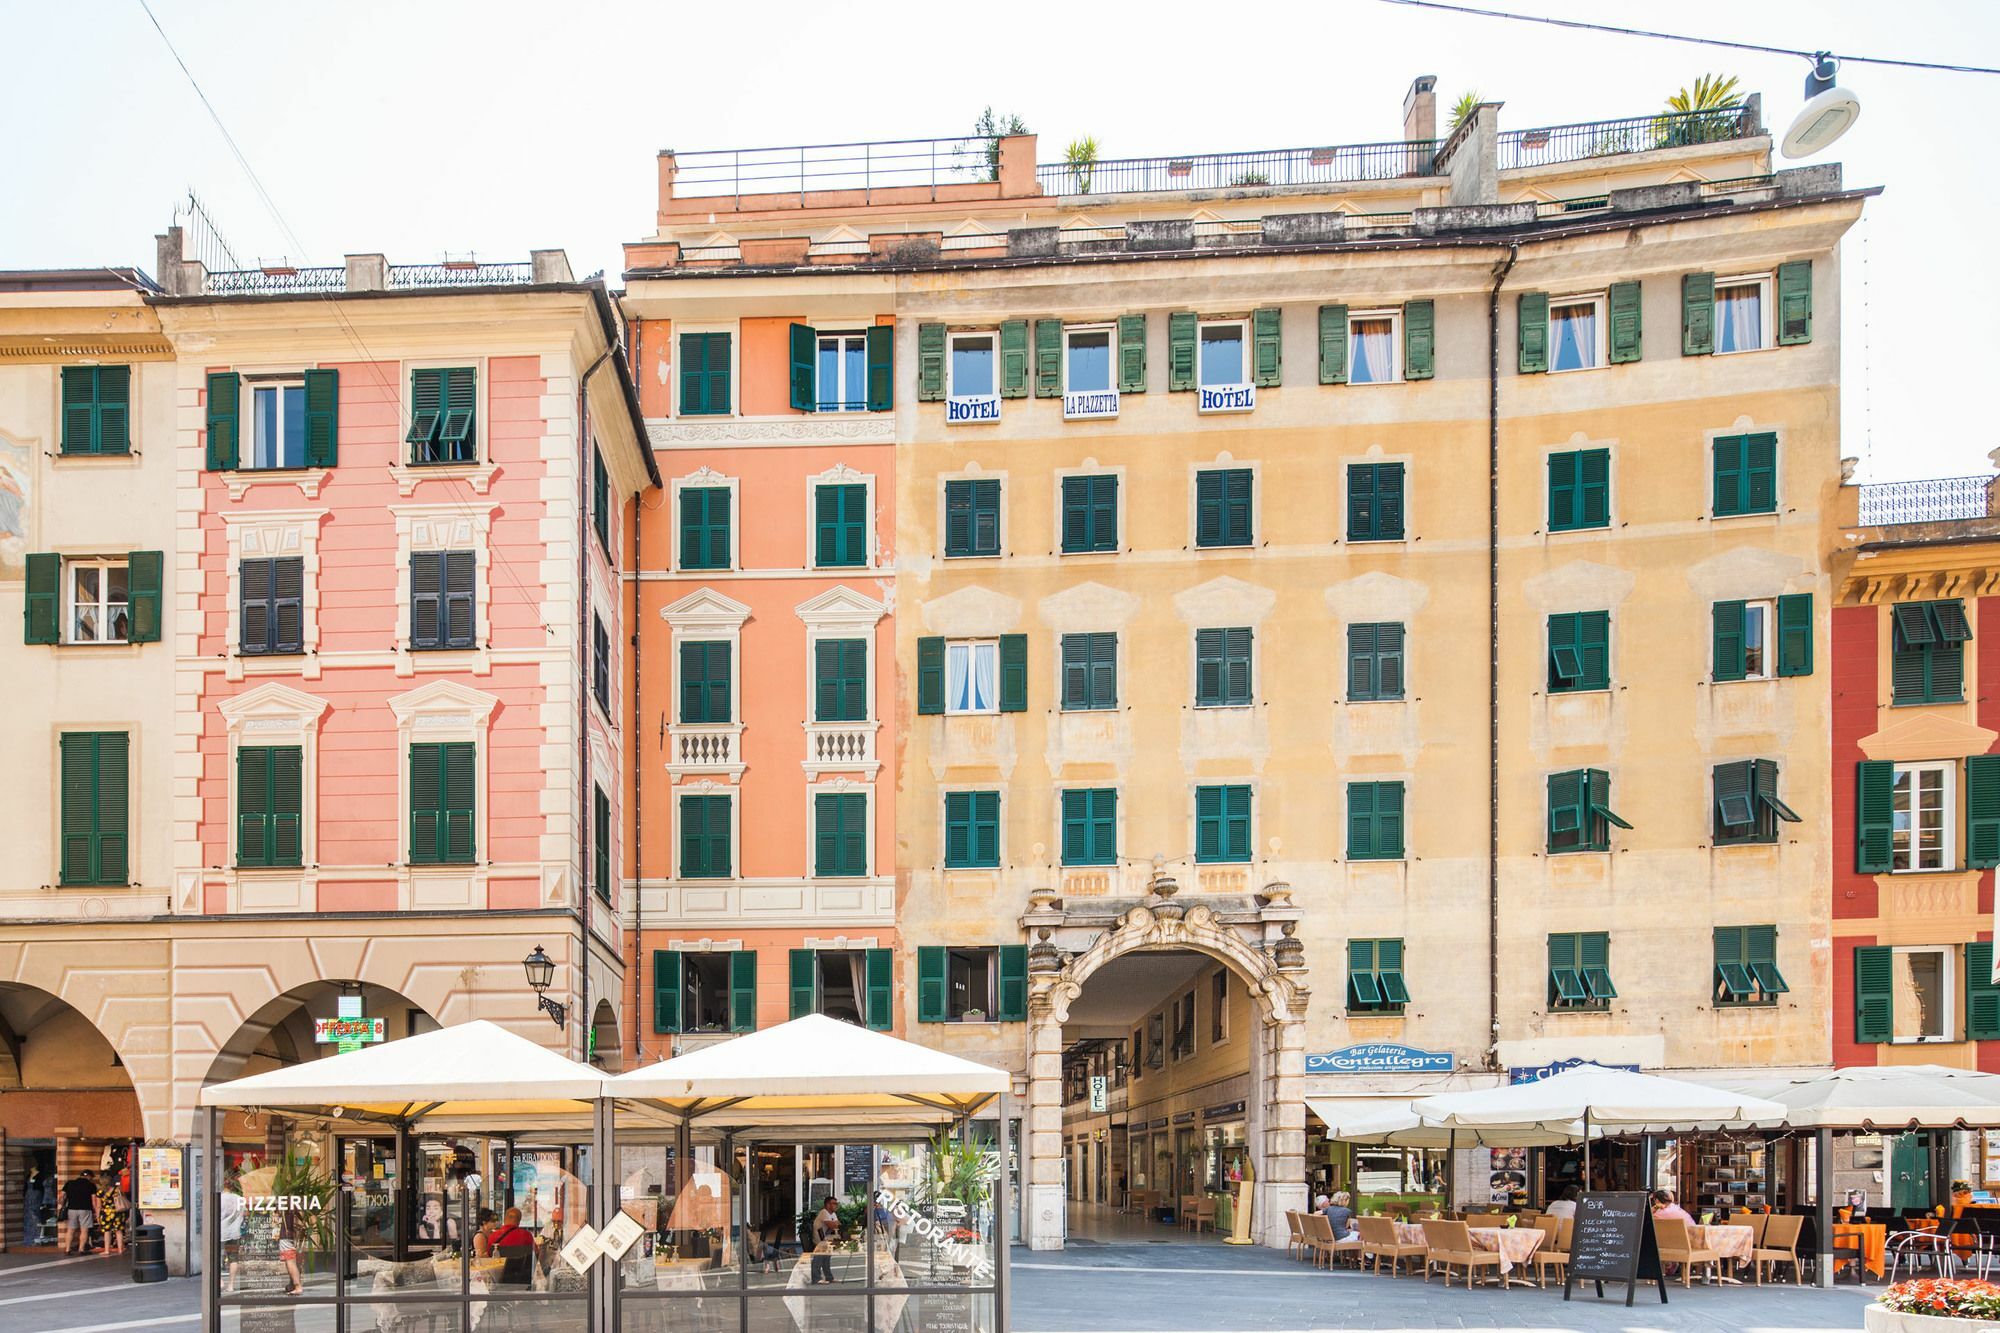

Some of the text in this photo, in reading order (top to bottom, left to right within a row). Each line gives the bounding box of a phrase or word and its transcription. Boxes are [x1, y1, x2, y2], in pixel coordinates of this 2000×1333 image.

[1066, 394, 1118, 414] LA PIAZZETTA
[1201, 388, 1253, 409] HOTEL
[949, 400, 999, 420] HOTEL
[1350, 1045, 1407, 1057] Bar Gelateria
[1308, 1056, 1449, 1070] Montallegro
[1093, 1077, 1103, 1107] HOTEL
[236, 1195, 321, 1211] PIZZERIA
[876, 1189, 993, 1280] RISTORANTE
